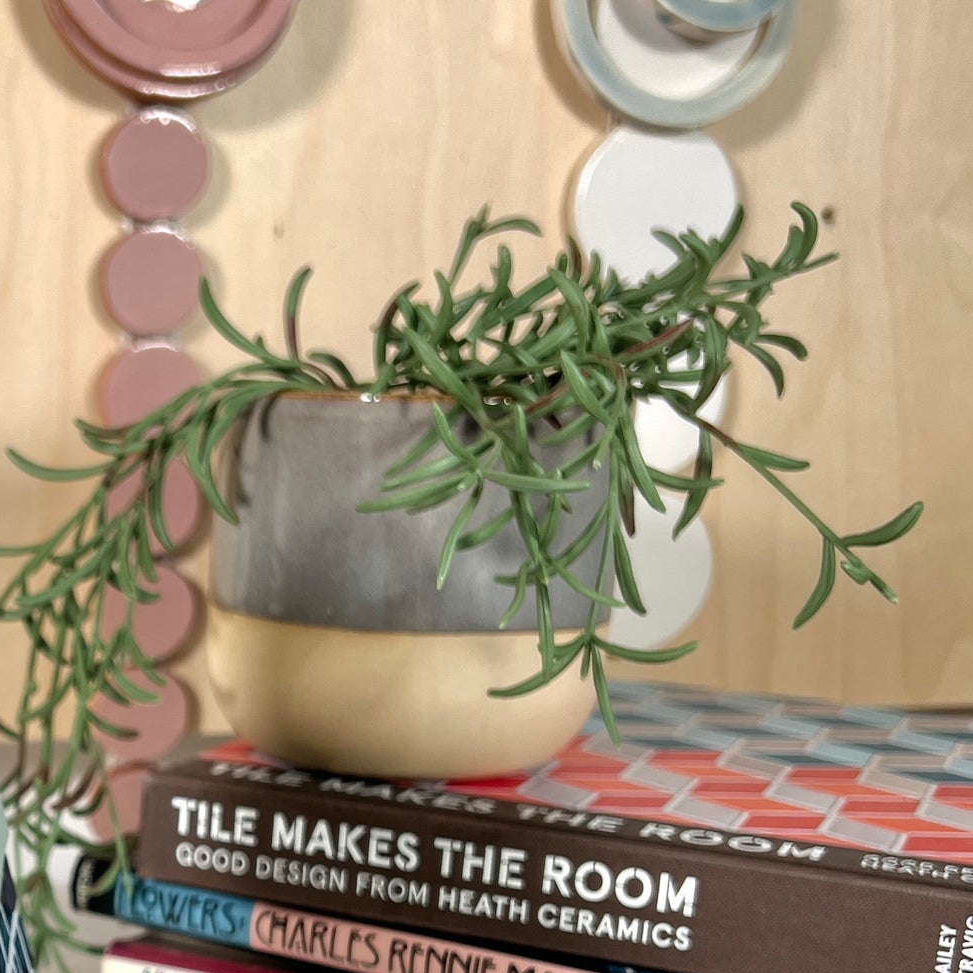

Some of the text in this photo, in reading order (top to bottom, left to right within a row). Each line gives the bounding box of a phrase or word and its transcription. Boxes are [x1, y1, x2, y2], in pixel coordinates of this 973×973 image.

[172, 795, 699, 918] TILE MAKES THE ROOM
[516, 803, 625, 833] THE
[639, 822, 827, 862] ROOM
[176, 841, 694, 951] GOOD DESIGN FROM HEATH CERAMICS
[255, 909, 380, 969] CHARLES
